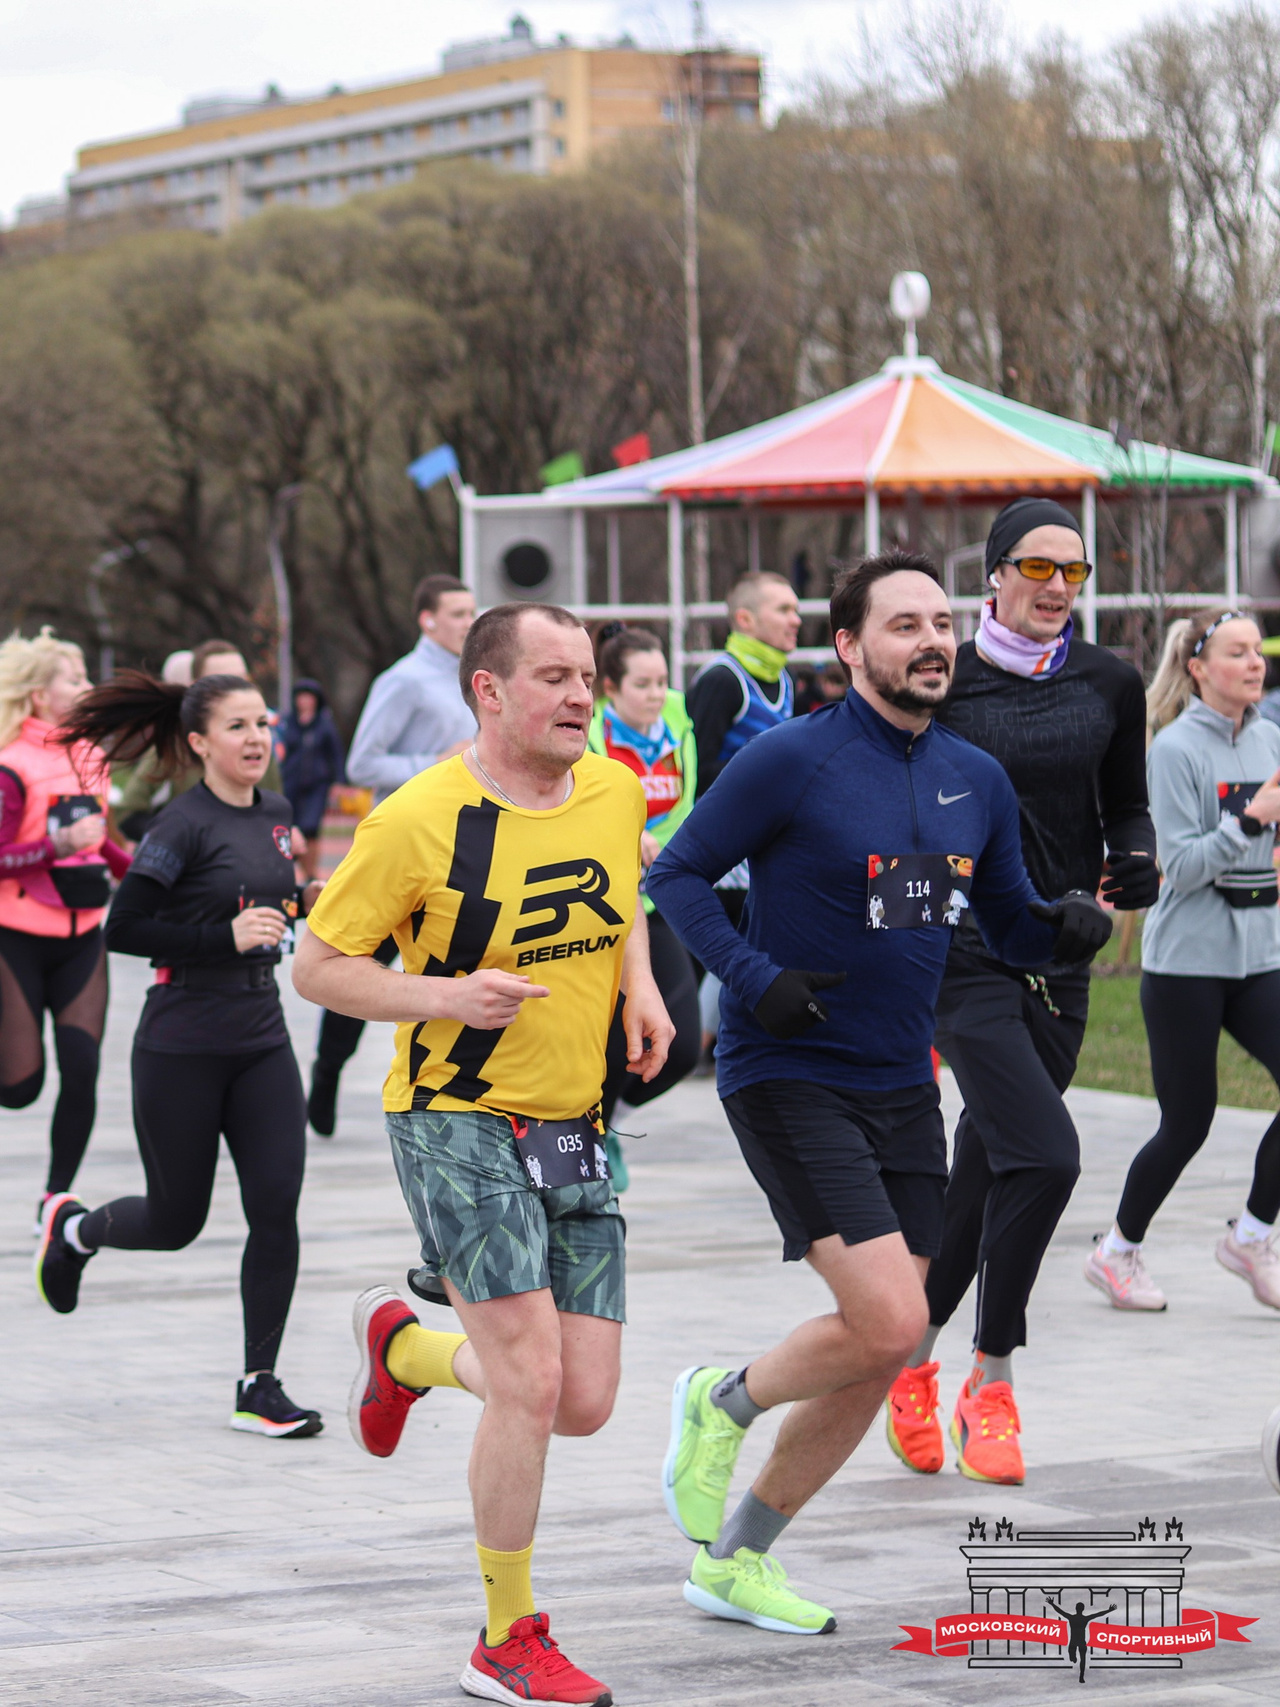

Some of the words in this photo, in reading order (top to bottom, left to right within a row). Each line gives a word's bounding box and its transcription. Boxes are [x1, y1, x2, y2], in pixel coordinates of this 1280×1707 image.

[906, 880, 931, 898] 114
[516, 934, 620, 968] BEERUN
[557, 1133, 583, 1153] 035
